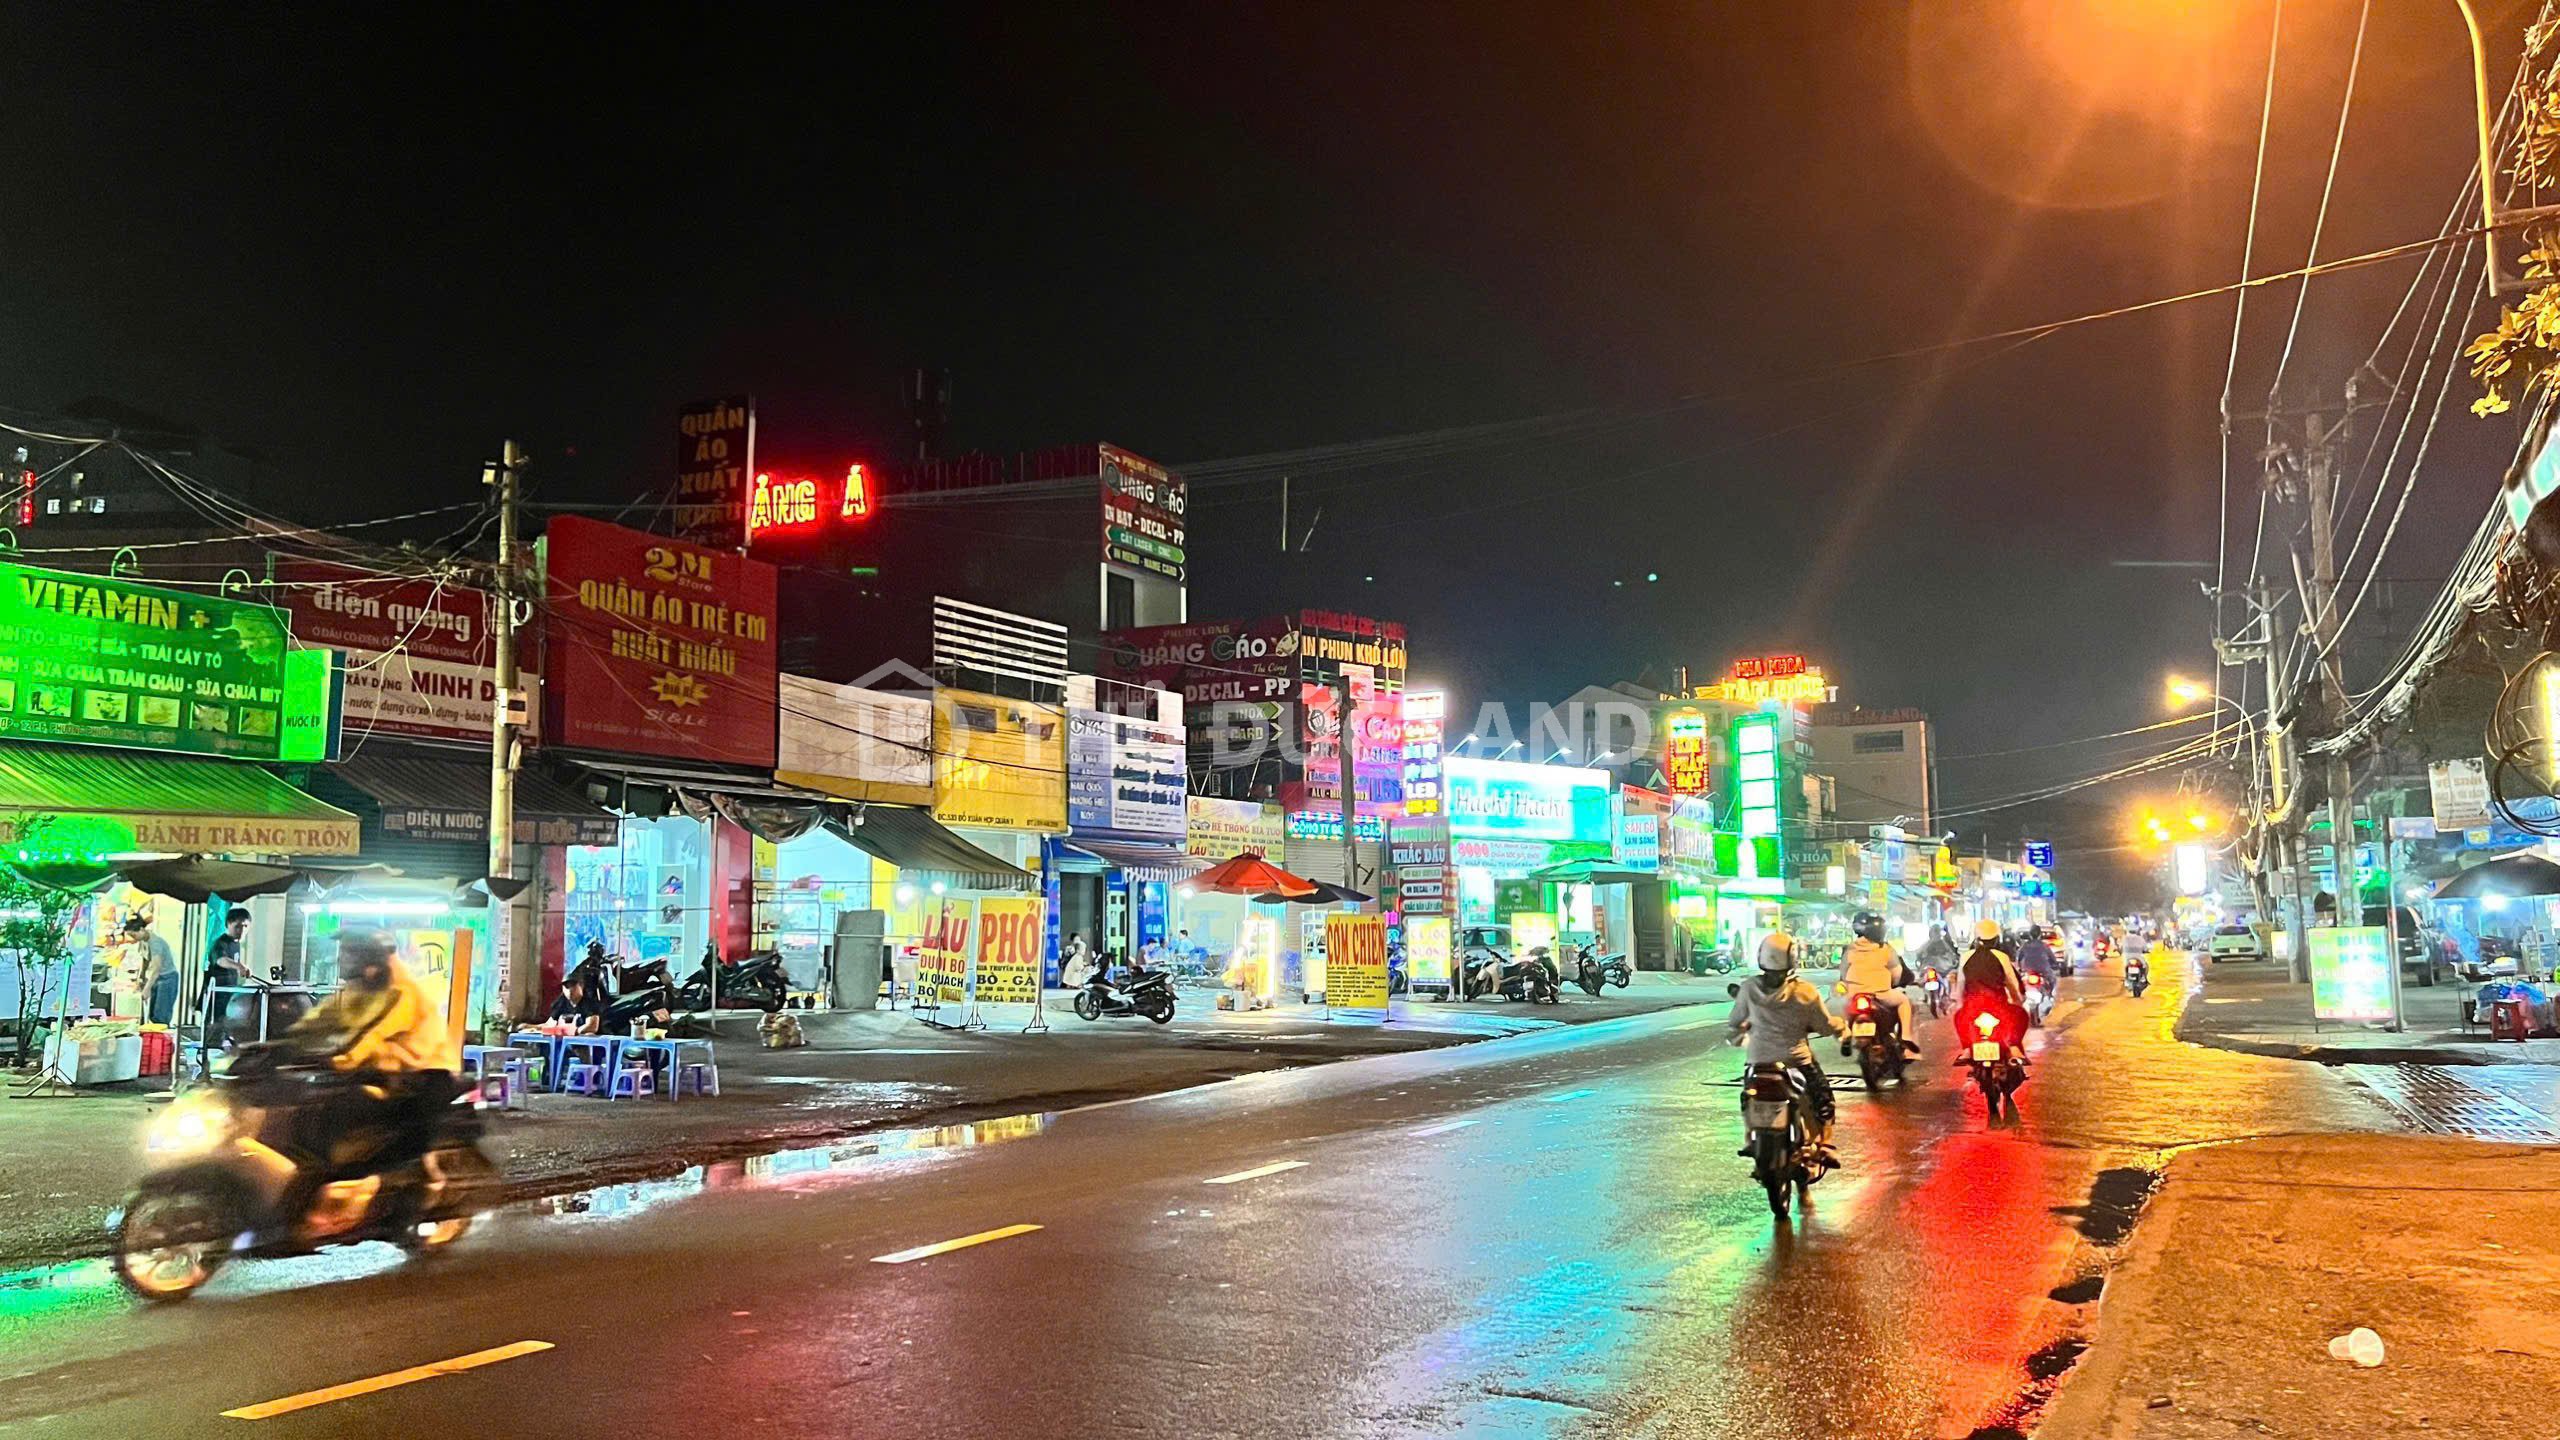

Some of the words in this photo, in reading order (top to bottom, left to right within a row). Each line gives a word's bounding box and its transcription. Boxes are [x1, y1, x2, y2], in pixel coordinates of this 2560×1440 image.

[1140, 517, 1168, 541] DECAL
[678, 576, 713, 592] Store
[20, 577, 180, 630] VITAMIN
[580, 577, 646, 617] QUẦN
[652, 590, 683, 626] ÁO
[690, 601, 729, 634] TRẺ
[734, 610, 767, 642] EM
[387, 602, 471, 642] quang
[1301, 635, 1316, 657] IN
[1319, 637, 1353, 662] PHUN
[1356, 637, 1382, 666] KHỔ
[411, 670, 473, 700] MINH
[1185, 681, 1245, 702] DECAL
[1264, 677, 1291, 697] PP
[135, 819, 200, 845] BÁNH
[1393, 843, 1422, 864] KHẮC
[1424, 843, 1446, 864] DẤU
[922, 902, 968, 953] LẨU
[979, 900, 1041, 964] PHỞ
[1327, 916, 1349, 966] CƠM
[1353, 915, 1386, 966] CHIÊN
[976, 972, 998, 985] BÒ
[1012, 973, 1036, 986] GÀ
